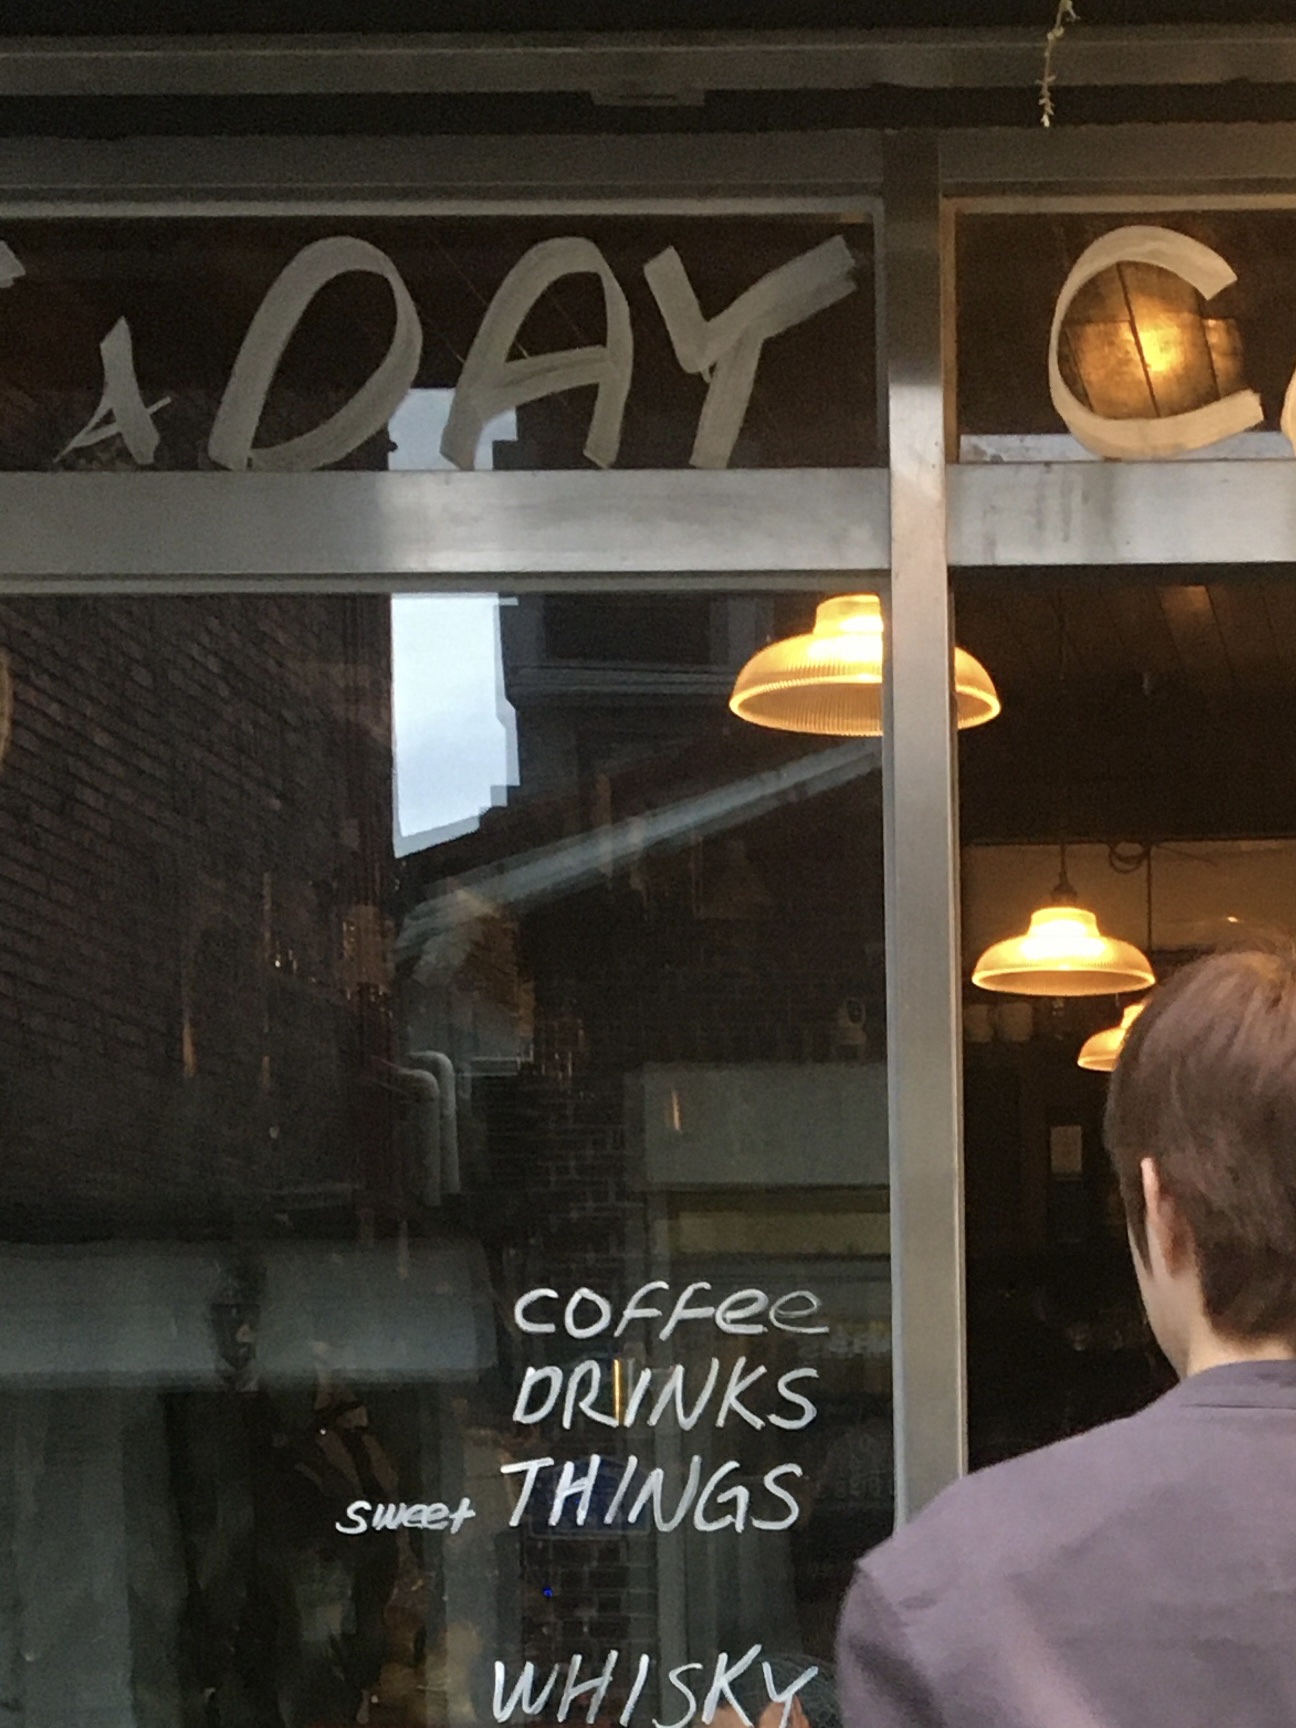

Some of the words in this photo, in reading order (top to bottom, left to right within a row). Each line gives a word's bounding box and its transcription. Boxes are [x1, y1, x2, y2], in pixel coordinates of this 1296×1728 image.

[207, 235, 858, 470] DAY
[513, 1355, 820, 1431] DRINKS
[500, 1453, 804, 1534] THINGS
